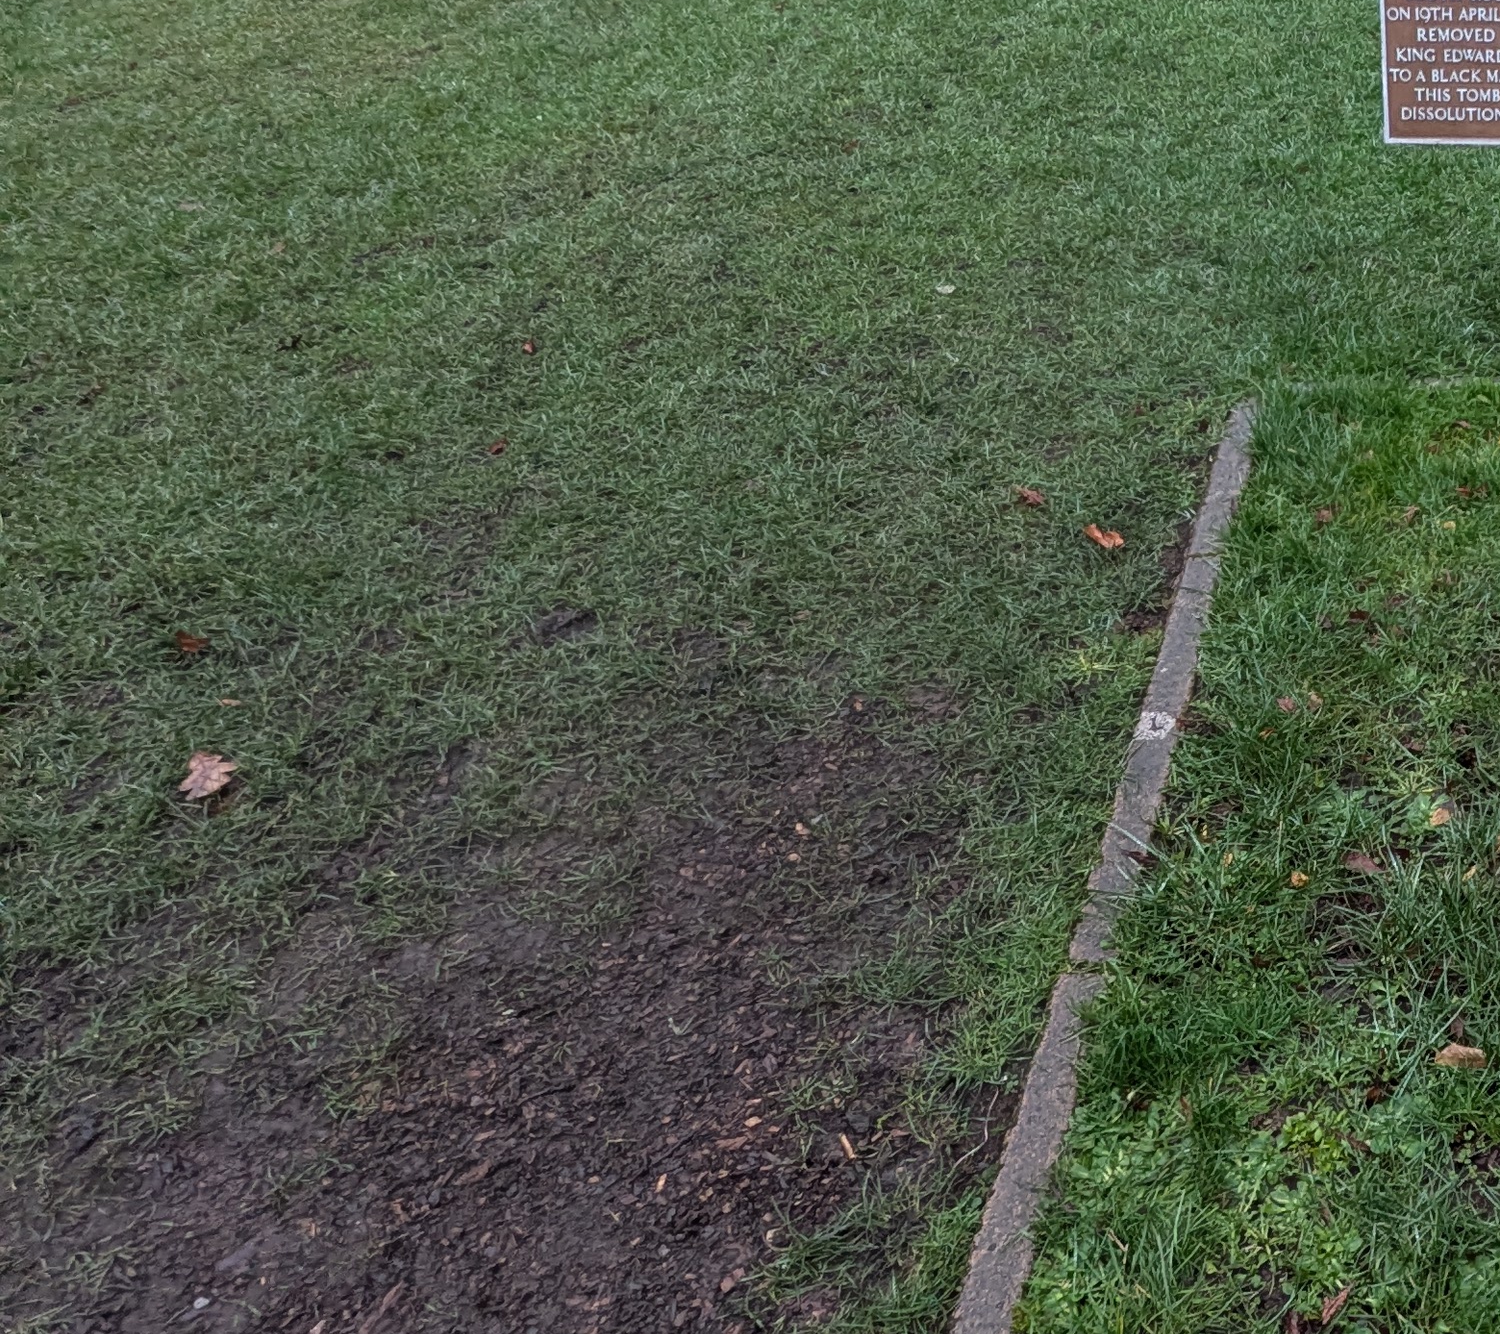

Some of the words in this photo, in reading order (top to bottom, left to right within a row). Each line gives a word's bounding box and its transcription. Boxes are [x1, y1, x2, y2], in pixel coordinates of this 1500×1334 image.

[1386, 6, 1410, 21] ON
[1415, 6, 1453, 23] 19TH
[1417, 27, 1495, 42] REMOVED
[1396, 47, 1436, 62] KING
[1389, 68, 1412, 82] TO
[1416, 70, 1426, 82] A
[1431, 68, 1482, 83] BLACK
[1414, 87, 1451, 102] THIS
[1456, 88, 1500, 102] TOMB
